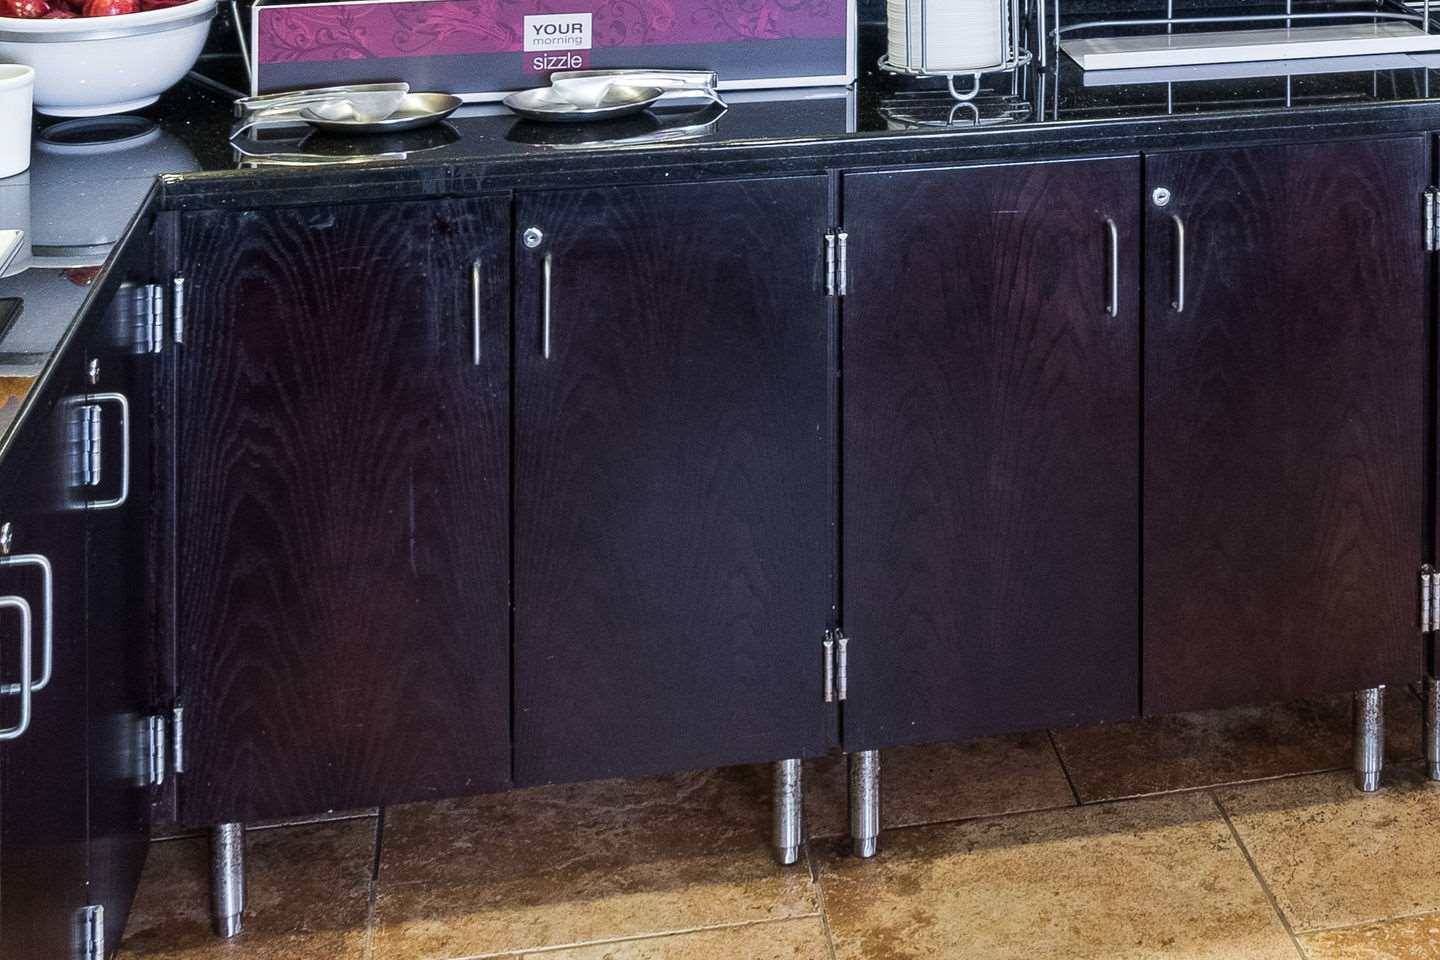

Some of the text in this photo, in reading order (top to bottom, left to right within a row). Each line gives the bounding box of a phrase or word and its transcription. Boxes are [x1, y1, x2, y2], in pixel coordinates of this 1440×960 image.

[532, 23, 584, 36] YOUR
[532, 35, 584, 46] morning
[533, 52, 583, 71] sizzle
